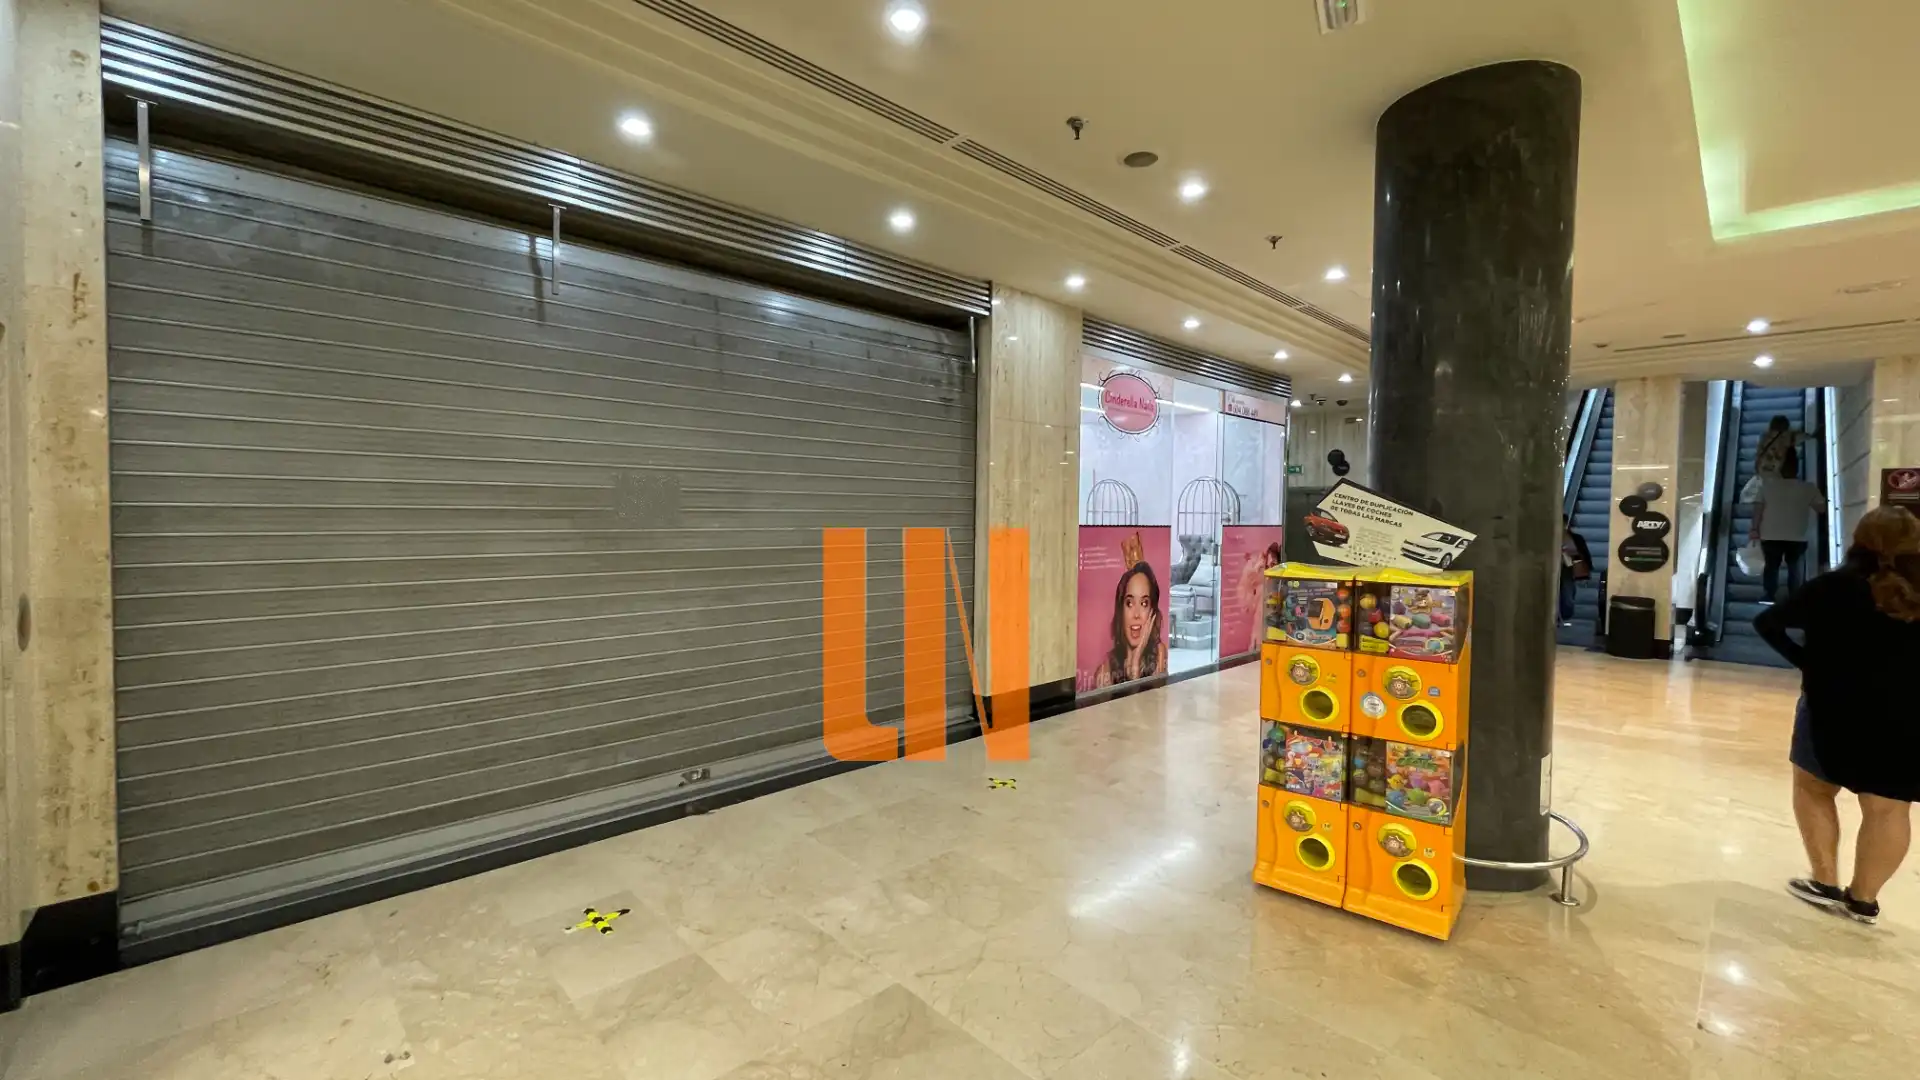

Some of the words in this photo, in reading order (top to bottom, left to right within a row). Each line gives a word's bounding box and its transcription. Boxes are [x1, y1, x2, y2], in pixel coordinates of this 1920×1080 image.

[1332, 499, 1356, 509] LLAVES
[1366, 507, 1392, 518] COCHES
[1334, 492, 1360, 503] CENTRO
[1369, 501, 1414, 516] DUPLICACIÓN
[1340, 507, 1361, 517] TODAS
[1361, 512, 1374, 520] LAS
[1374, 516, 1403, 527] MARCAS
